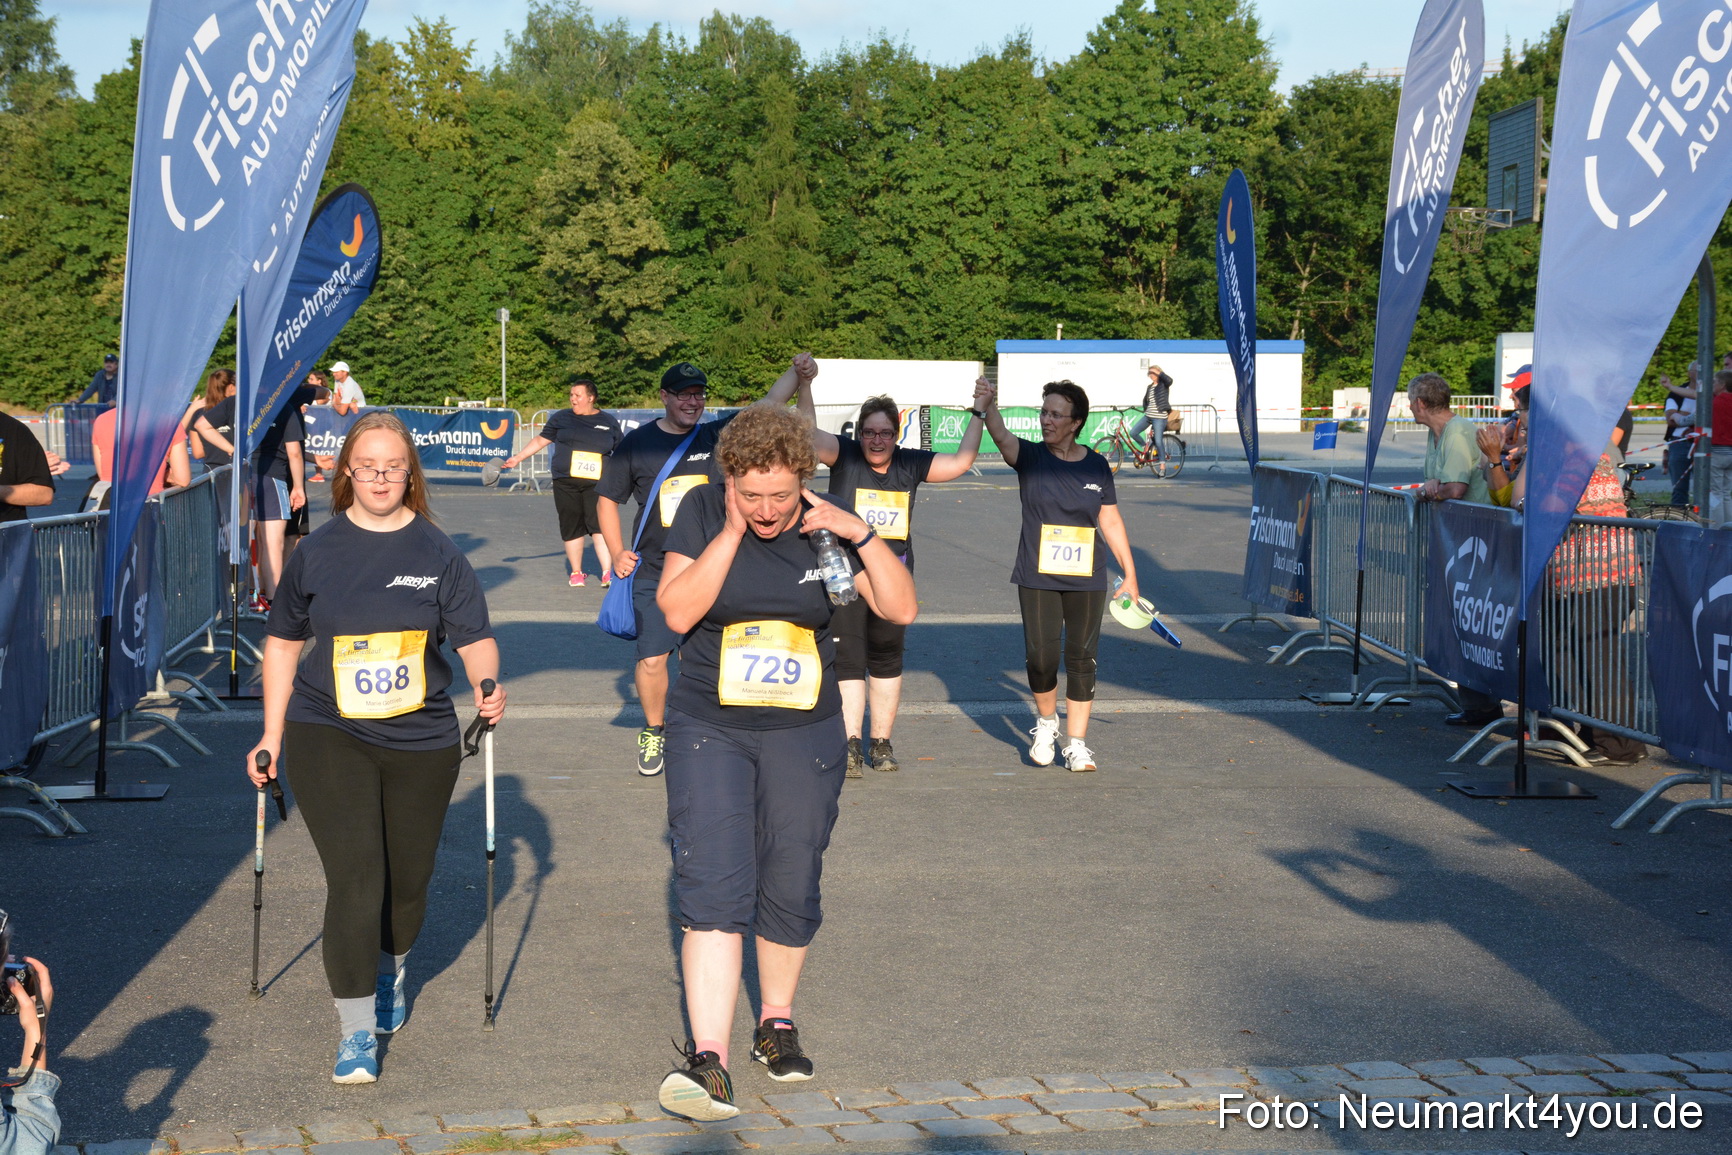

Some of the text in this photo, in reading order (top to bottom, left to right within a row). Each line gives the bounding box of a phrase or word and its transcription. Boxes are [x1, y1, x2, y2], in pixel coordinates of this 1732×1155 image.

[241, 0, 336, 187] AUTOMOBIL
[1626, 0, 1732, 178] Fisc
[1407, 16, 1467, 237] Fischer
[274, 260, 351, 360] Frischmann
[935, 415, 965, 438] AOK
[1091, 415, 1137, 438] AOK
[445, 445, 508, 457] Druck und Medien
[577, 461, 596, 472] 746
[865, 509, 899, 527] 697
[1250, 505, 1297, 550] Frischmann
[1051, 545, 1082, 562] 701
[1453, 581, 1514, 641] Fischer
[354, 664, 410, 695] 688
[741, 653, 802, 685] 729
